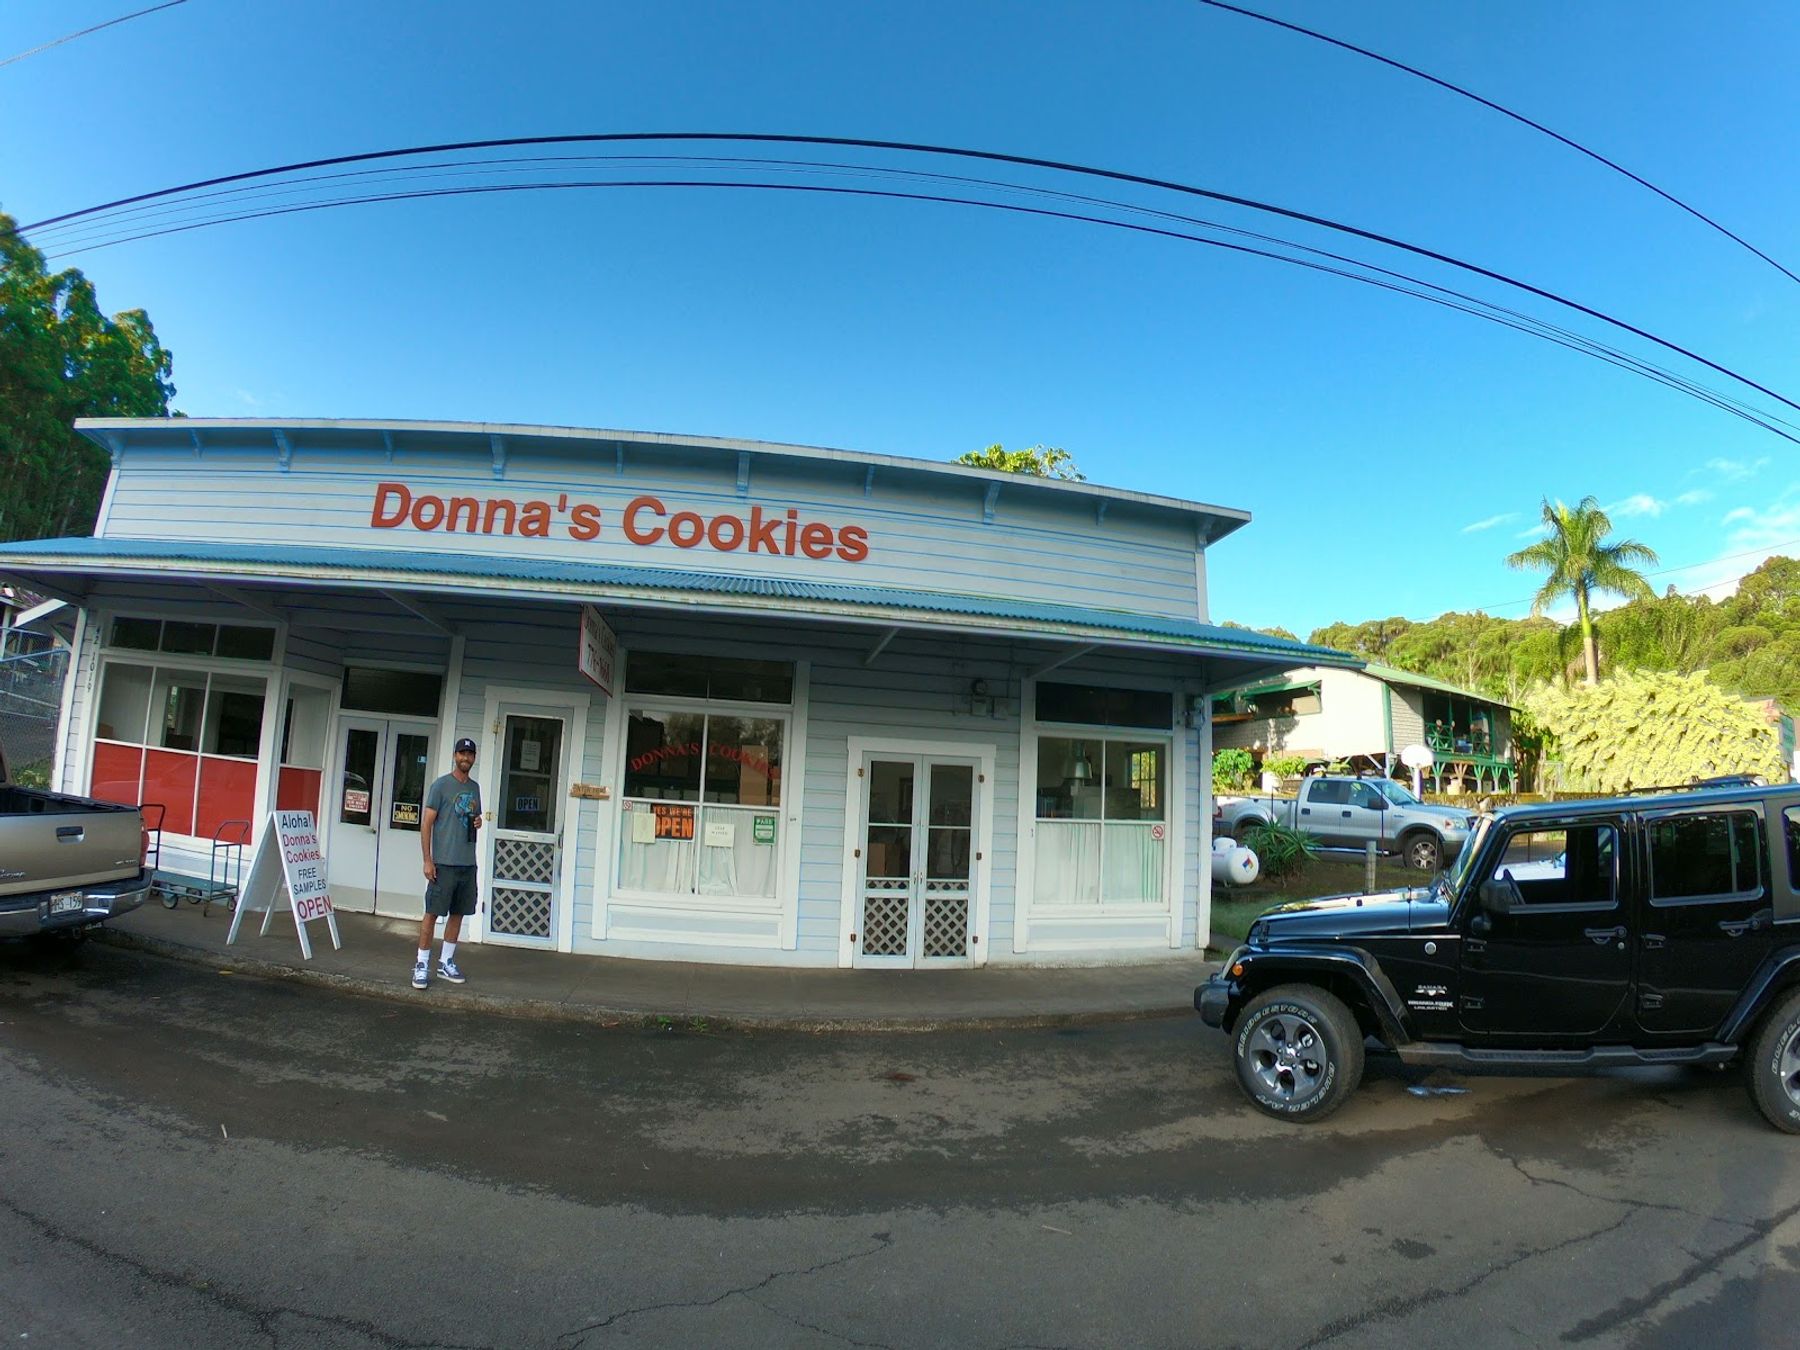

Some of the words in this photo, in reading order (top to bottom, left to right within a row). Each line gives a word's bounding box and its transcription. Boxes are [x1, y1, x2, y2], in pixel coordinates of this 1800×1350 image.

[371, 482, 601, 541] Donna's
[622, 495, 869, 562] Cookies
[630, 743, 700, 772] DONNA'S
[517, 798, 539, 811] OPEN
[281, 814, 312, 829] Aloha!
[282, 833, 318, 847] Donna's
[286, 849, 320, 863] Cookies
[298, 867, 317, 880] FREE
[293, 878, 327, 896] SAMPLES
[297, 895, 332, 919] OPEN
